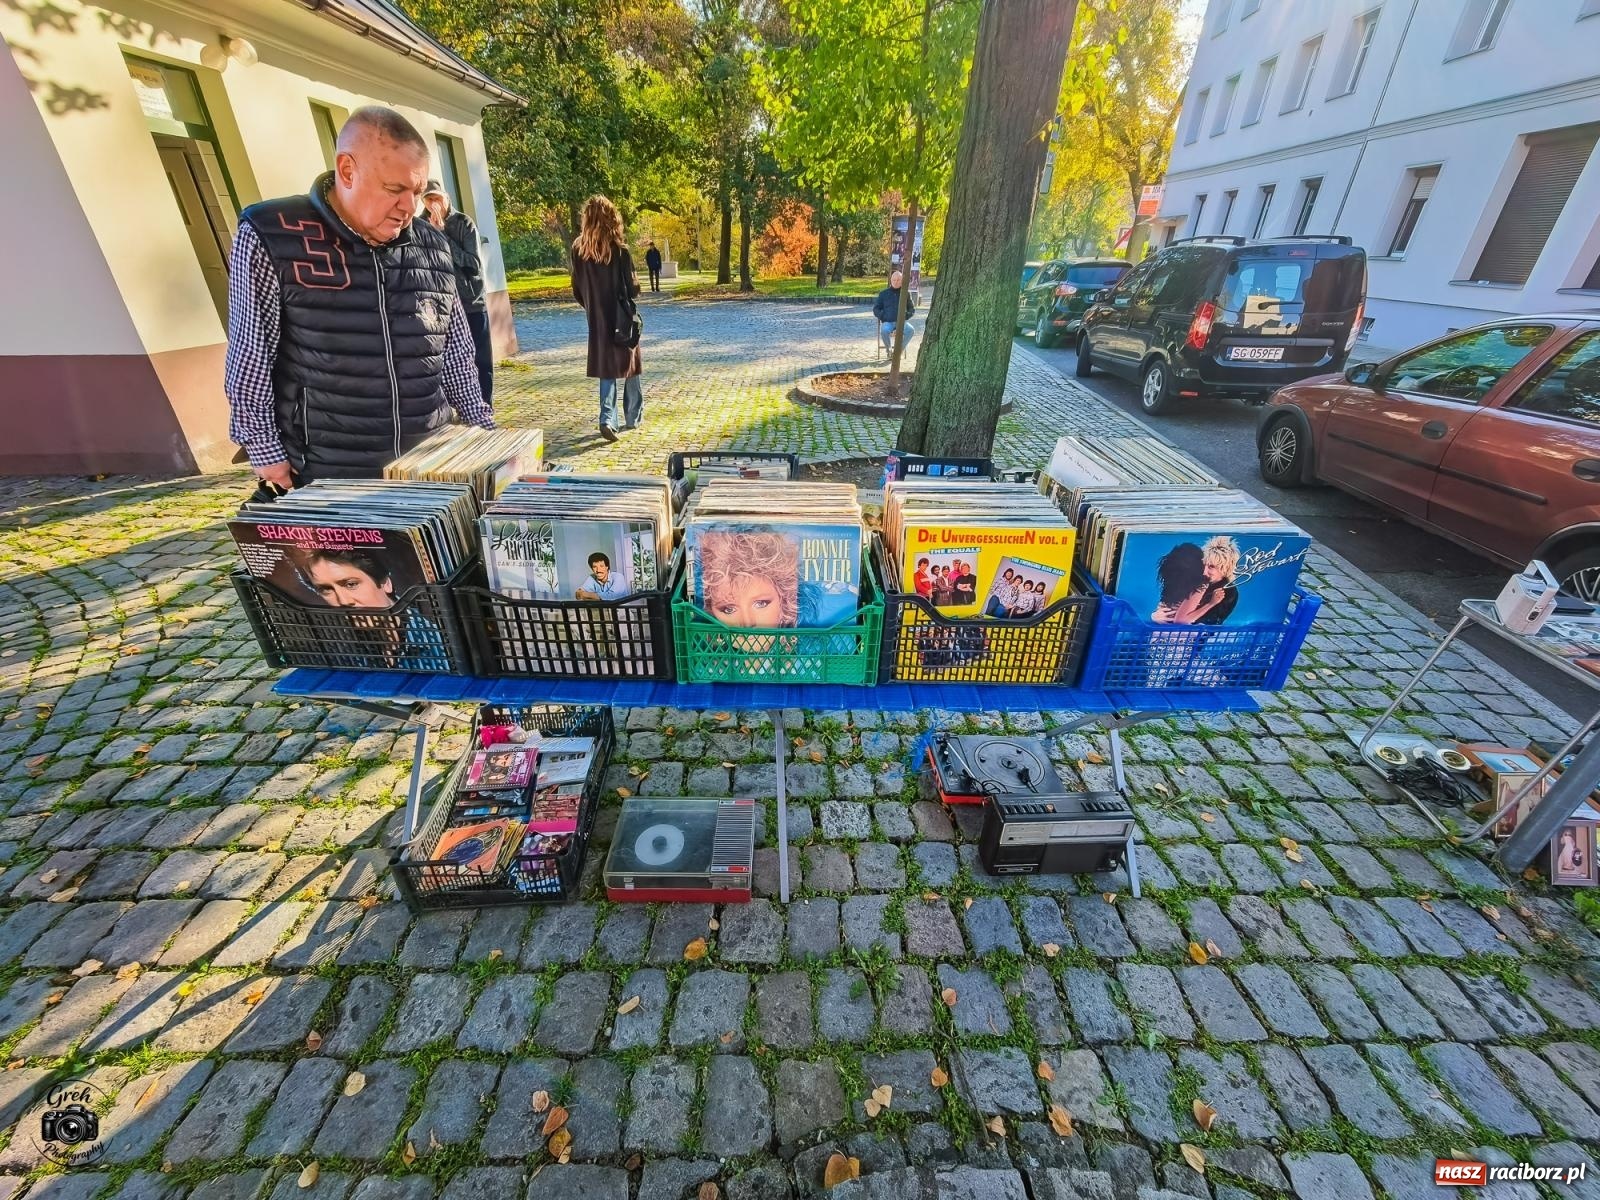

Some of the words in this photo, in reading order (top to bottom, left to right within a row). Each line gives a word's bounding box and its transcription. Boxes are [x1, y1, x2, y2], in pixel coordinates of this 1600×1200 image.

[277, 212, 351, 290] 3
[1233, 348, 1247, 358] SG
[1249, 348, 1281, 359] 059FF
[257, 525, 314, 540] SHAKIN'
[315, 527, 384, 543] STEVENS
[295, 541, 310, 549] and
[325, 543, 354, 551] Sunsets
[803, 539, 850, 558] BONNIE
[1236, 542, 1283, 571] Rod
[803, 559, 851, 582] TYLER
[1223, 547, 1309, 588] Stewart
